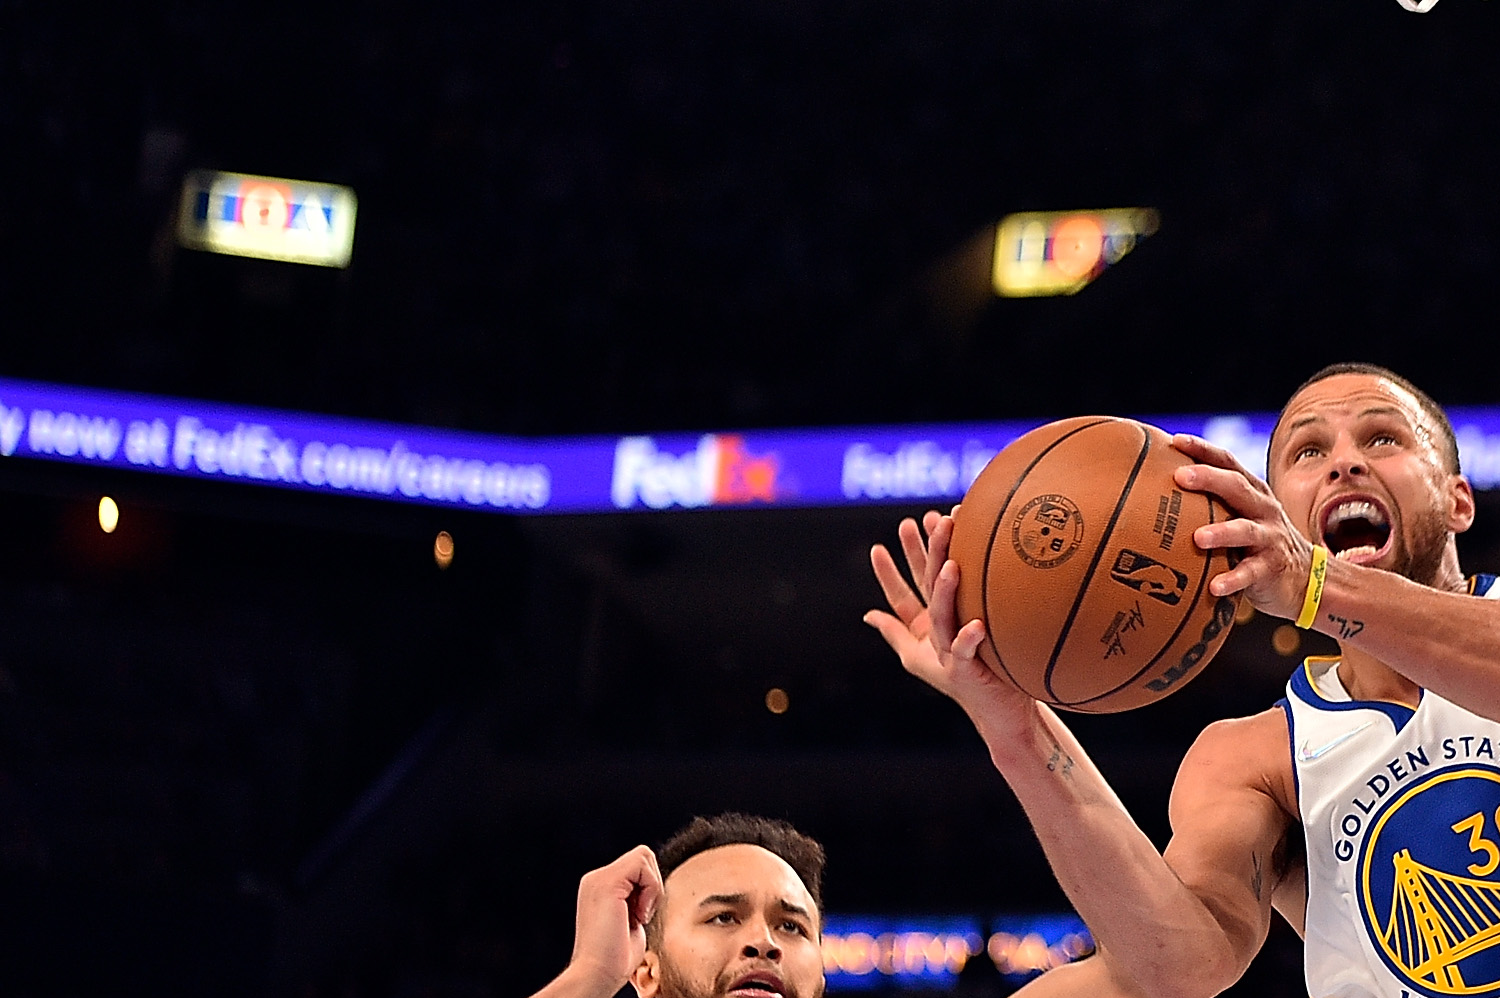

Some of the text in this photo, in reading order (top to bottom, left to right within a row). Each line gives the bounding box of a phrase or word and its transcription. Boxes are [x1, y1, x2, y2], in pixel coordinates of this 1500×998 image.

[28, 409, 122, 461] now
[124, 418, 169, 468] at
[612, 435, 774, 509] FedEx
[1335, 746, 1430, 861] GOLDEN
